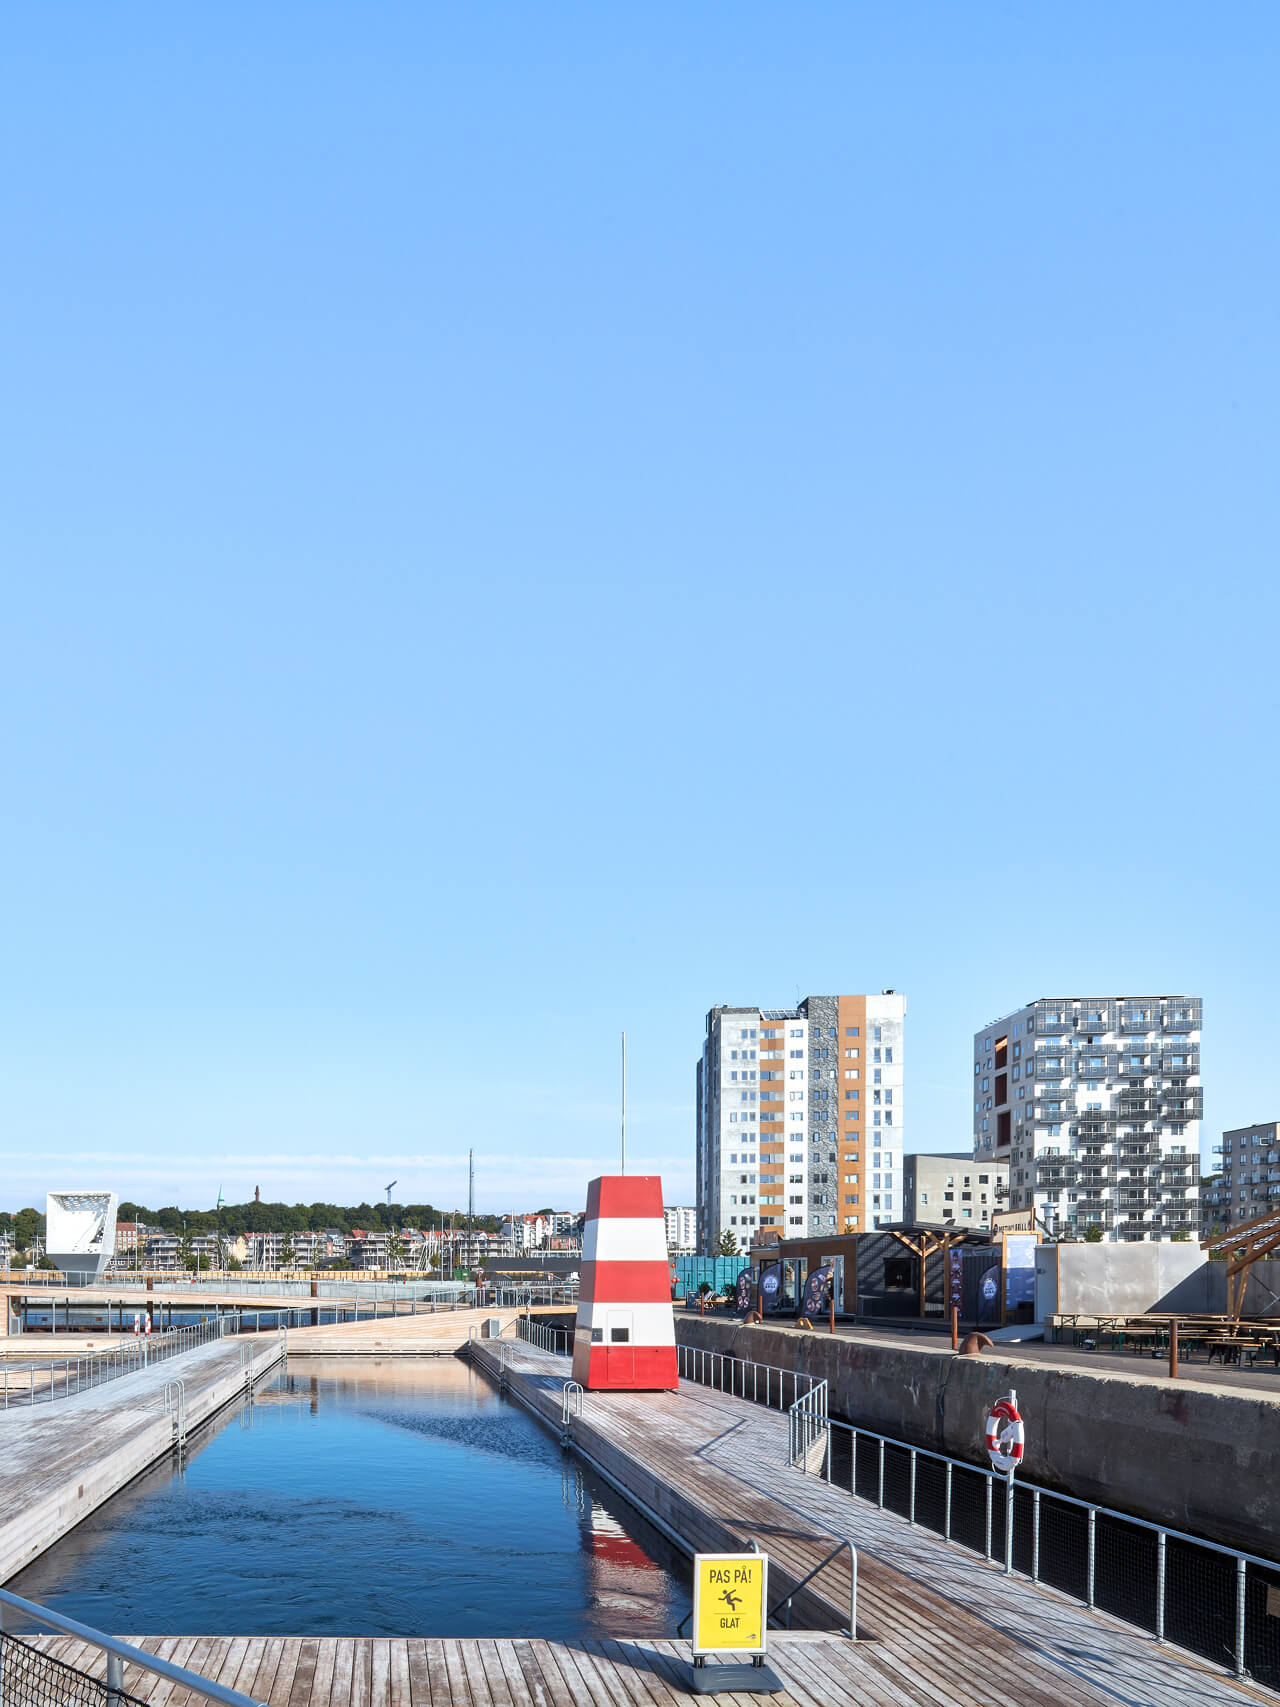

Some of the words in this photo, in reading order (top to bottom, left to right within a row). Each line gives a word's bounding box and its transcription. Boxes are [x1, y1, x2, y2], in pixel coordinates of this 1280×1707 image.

[709, 1569, 730, 1583] PAS
[734, 1565, 751, 1583] PÅ!
[720, 1617, 740, 1629] GLAT
